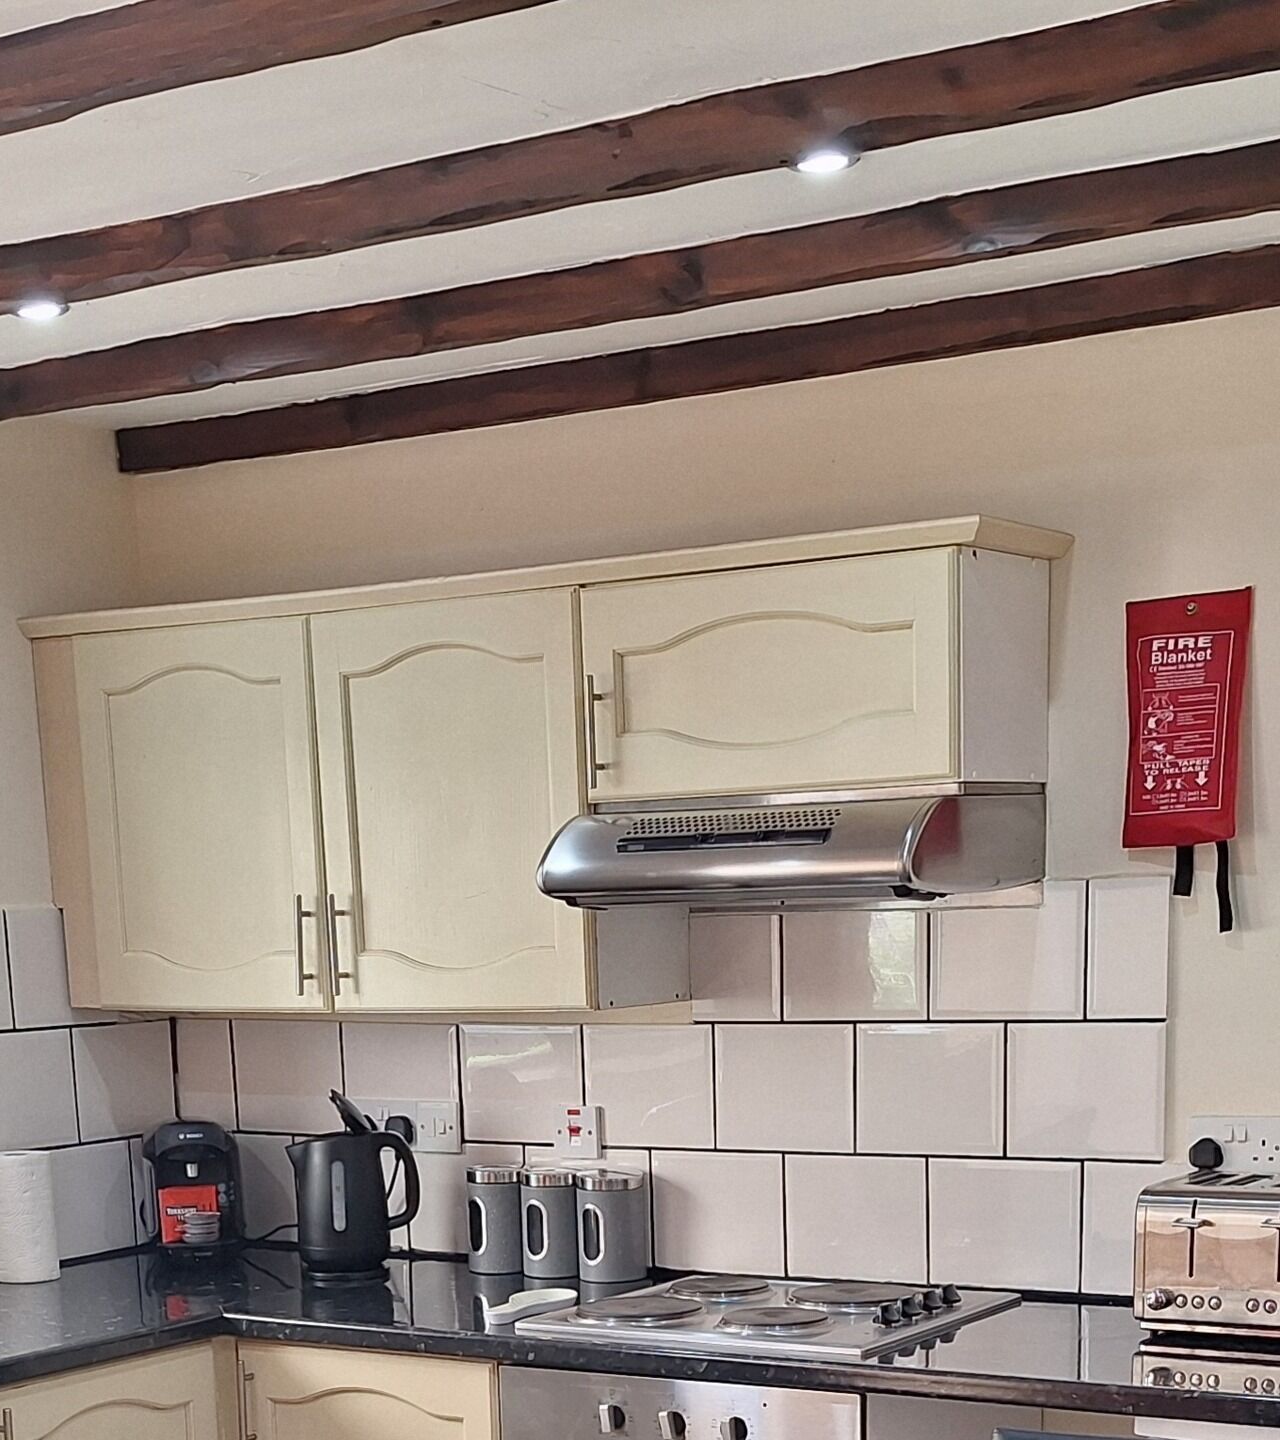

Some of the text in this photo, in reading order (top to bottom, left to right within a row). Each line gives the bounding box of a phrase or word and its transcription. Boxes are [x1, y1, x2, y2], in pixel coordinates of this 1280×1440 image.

[1152, 635, 1213, 652] FIRE
[1151, 648, 1212, 665] Blanket
[1163, 765, 1209, 775] RELEASE
